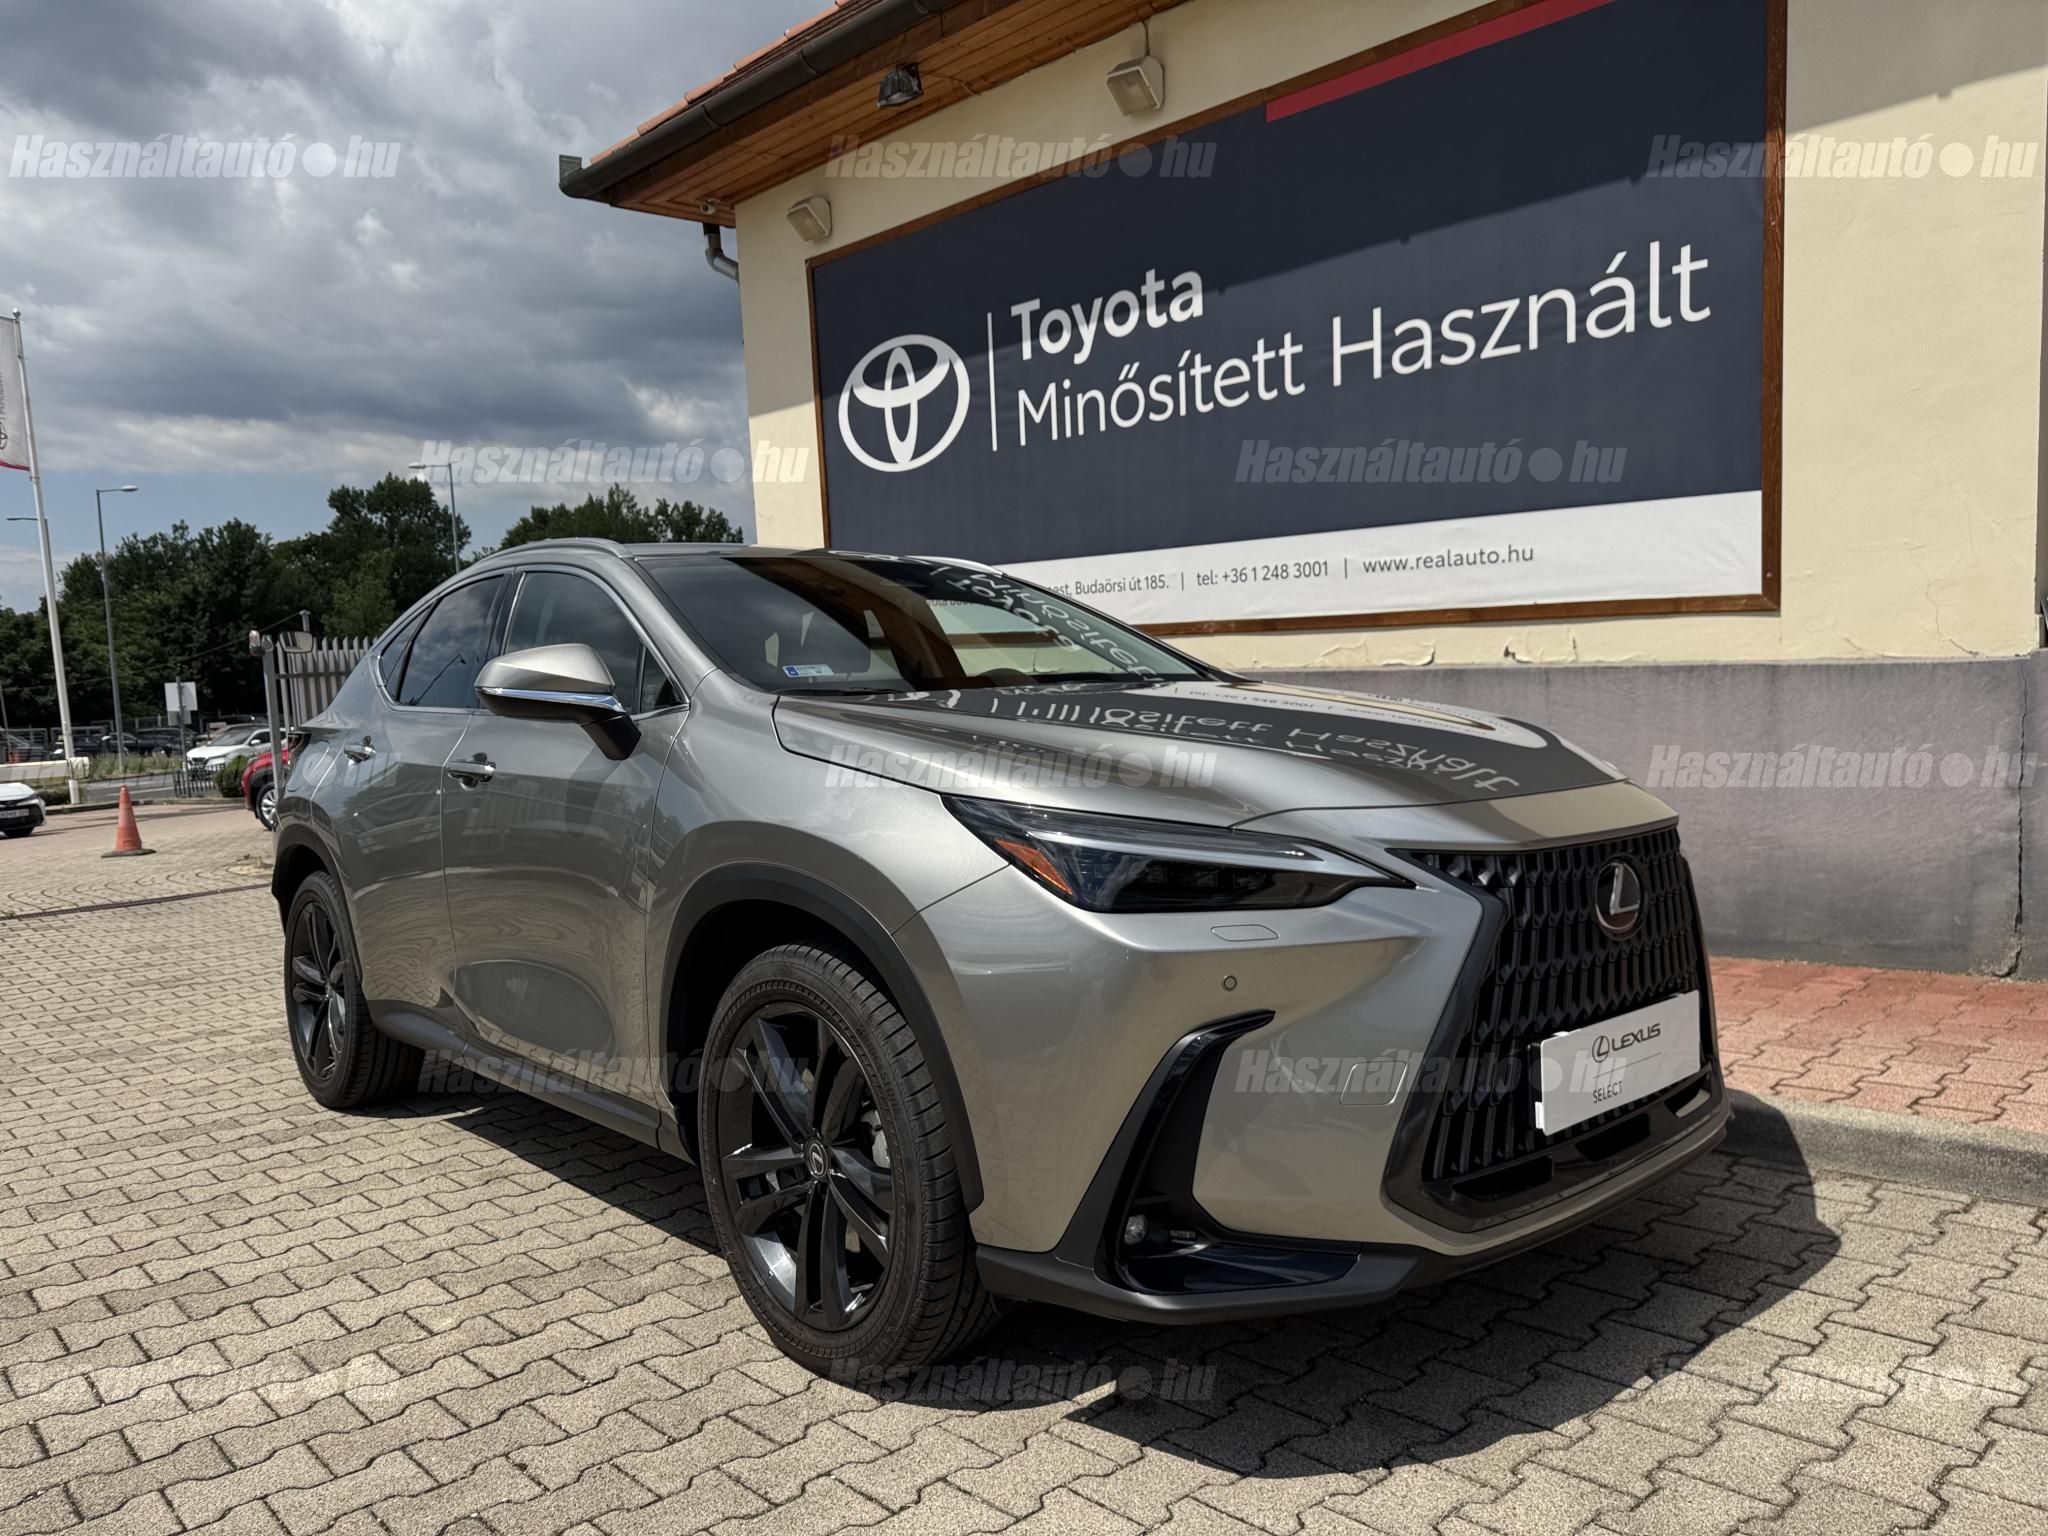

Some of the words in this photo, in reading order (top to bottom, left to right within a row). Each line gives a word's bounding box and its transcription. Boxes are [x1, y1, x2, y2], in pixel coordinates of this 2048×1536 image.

[1010, 268, 1204, 365] Toyota
[1016, 331, 1306, 447] Minősített
[1331, 240, 1712, 388] Használt
[1075, 577, 1126, 595] Budaörsi
[1129, 576, 1142, 591] út
[1144, 574, 1169, 590] 185.
[1196, 569, 1219, 586] tel:
[1222, 566, 1248, 584] +36
[1262, 563, 1289, 581] 248
[1293, 560, 1329, 579] 3001
[1362, 544, 1534, 573] www.realauto.hu
[1611, 1022, 1661, 1052] LEXUS
[1592, 1080, 1623, 1104] SELECT
